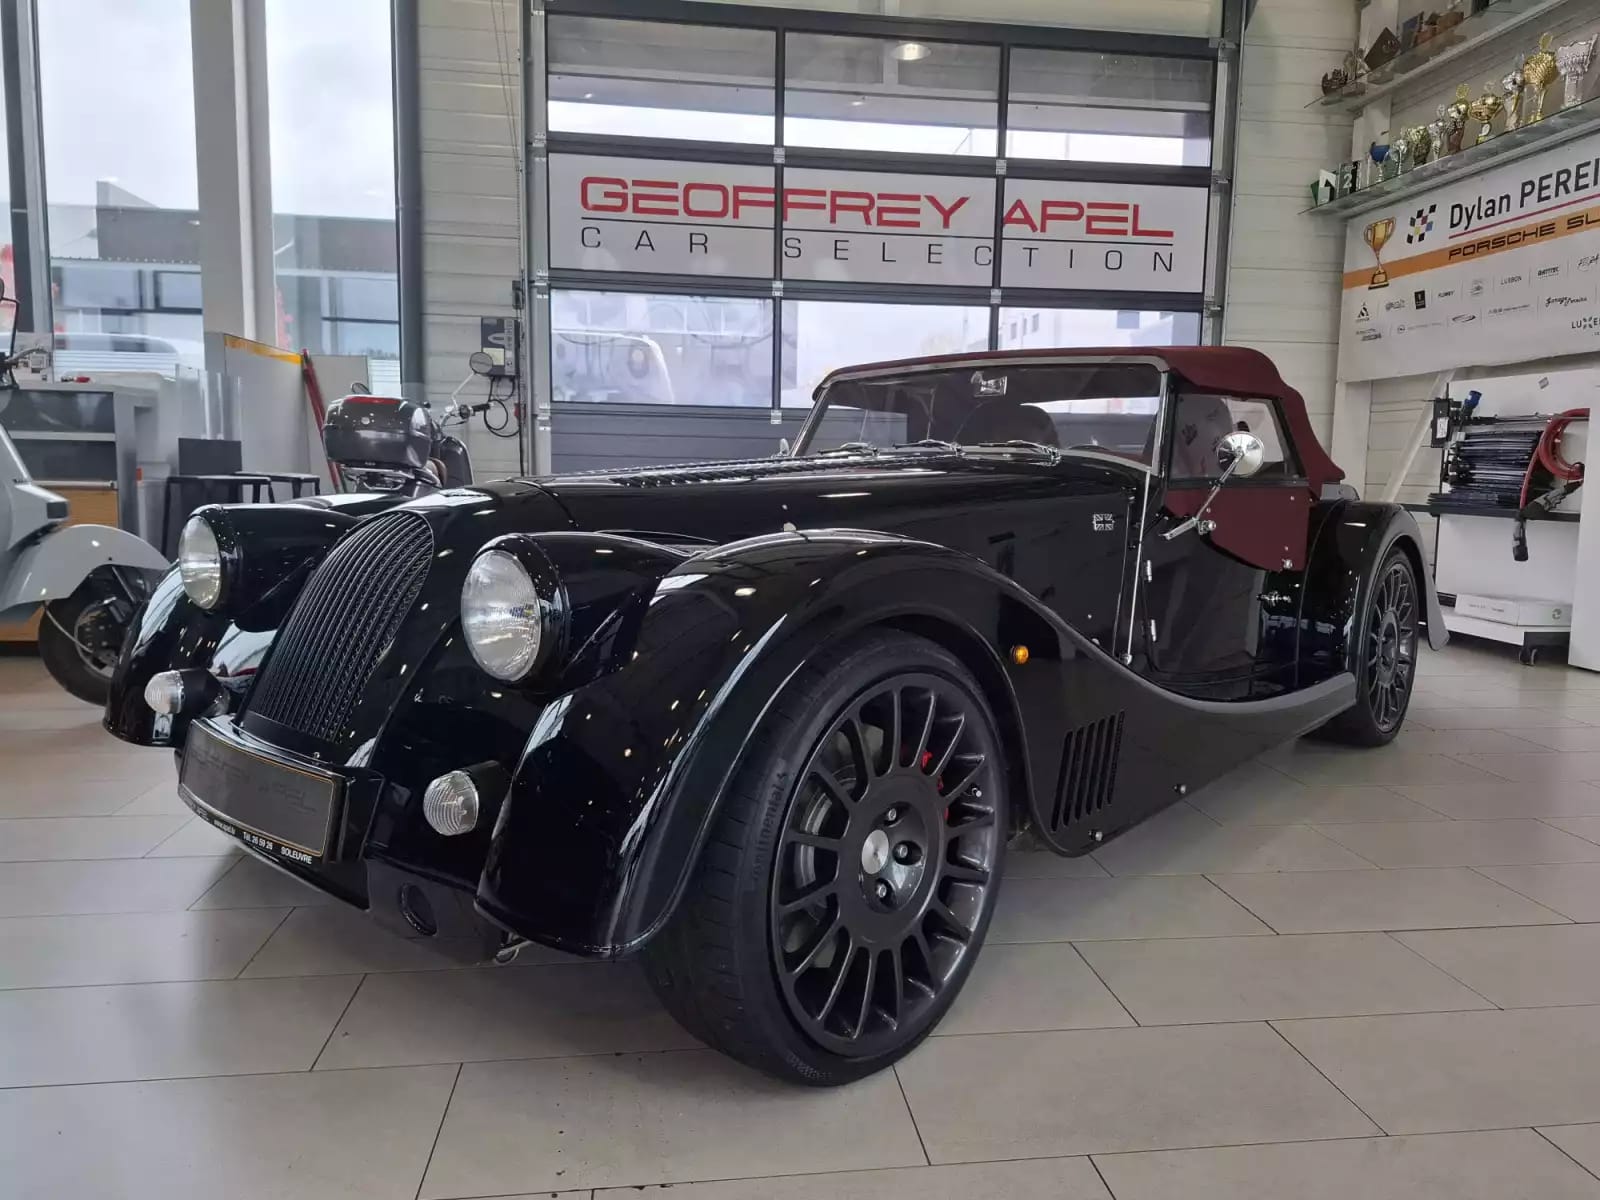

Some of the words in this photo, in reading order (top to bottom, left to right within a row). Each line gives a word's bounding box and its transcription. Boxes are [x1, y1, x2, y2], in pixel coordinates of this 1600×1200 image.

[581, 176, 970, 229] GEOFFREY
[1002, 198, 1174, 238] APEL
[1450, 193, 1511, 230] Dylan
[581, 226, 709, 254] CAR
[784, 237, 1173, 272] SELECTION
[1448, 223, 1556, 260] PORSCHE
[1571, 316, 1600, 330] LUXE
[280, 846, 312, 865] SOLEUVRE
